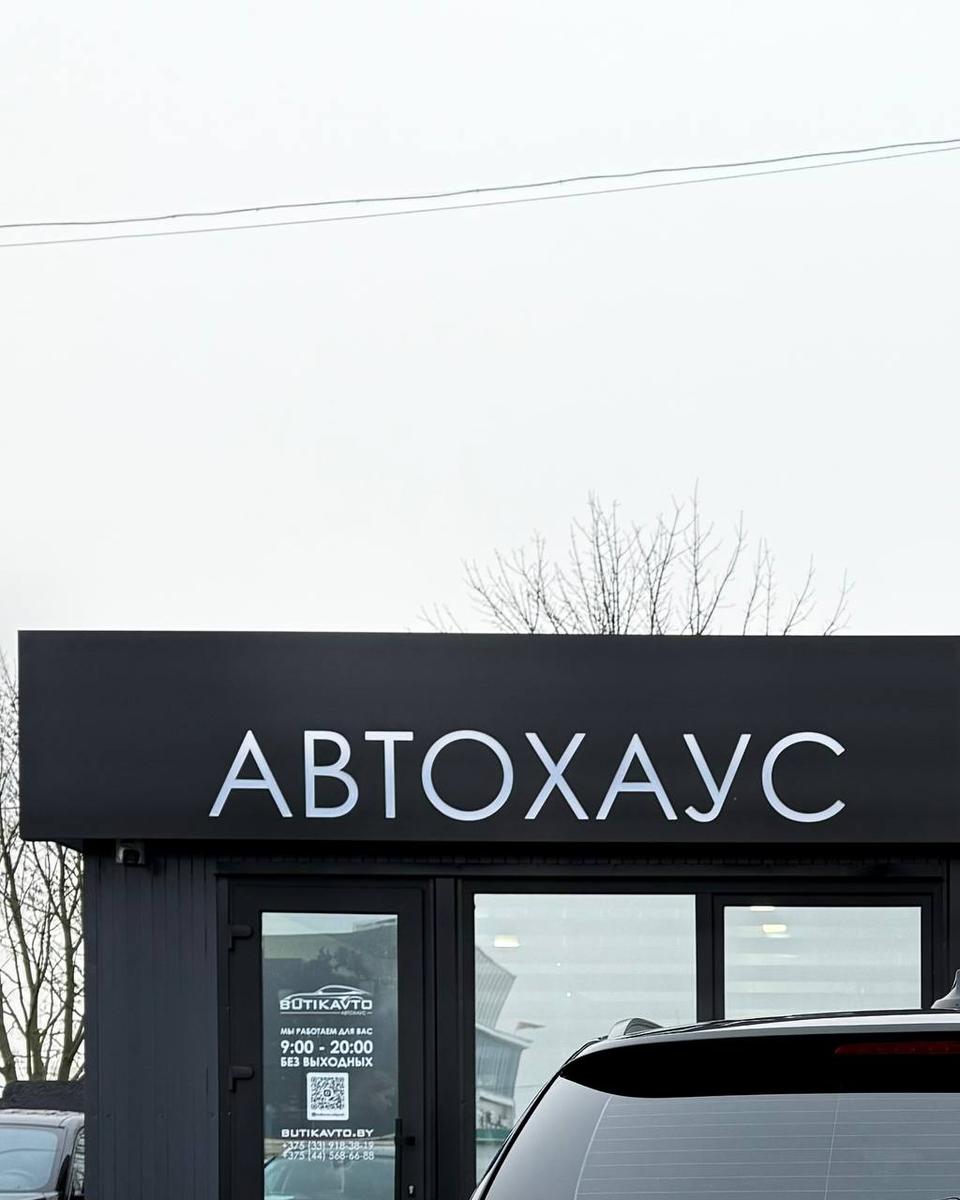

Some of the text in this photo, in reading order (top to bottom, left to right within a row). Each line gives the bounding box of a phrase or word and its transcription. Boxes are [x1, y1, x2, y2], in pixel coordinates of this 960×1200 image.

[208, 729, 846, 823] АВТОХАУС
[279, 999, 373, 1010] BUTIKAVTO
[338, 1028, 355, 1036] ДЛЯ
[280, 1040, 314, 1054] 9:00
[330, 1040, 373, 1054] 20:00
[280, 1057, 373, 1068] БЕЗ ВЫХОДНЫХ
[281, 1128, 374, 1138] BUTIKAVTO.BY
[282, 1141, 305, 1150] +375
[308, 1140, 325, 1151] (33)
[308, 1151, 326, 1162] (44)
